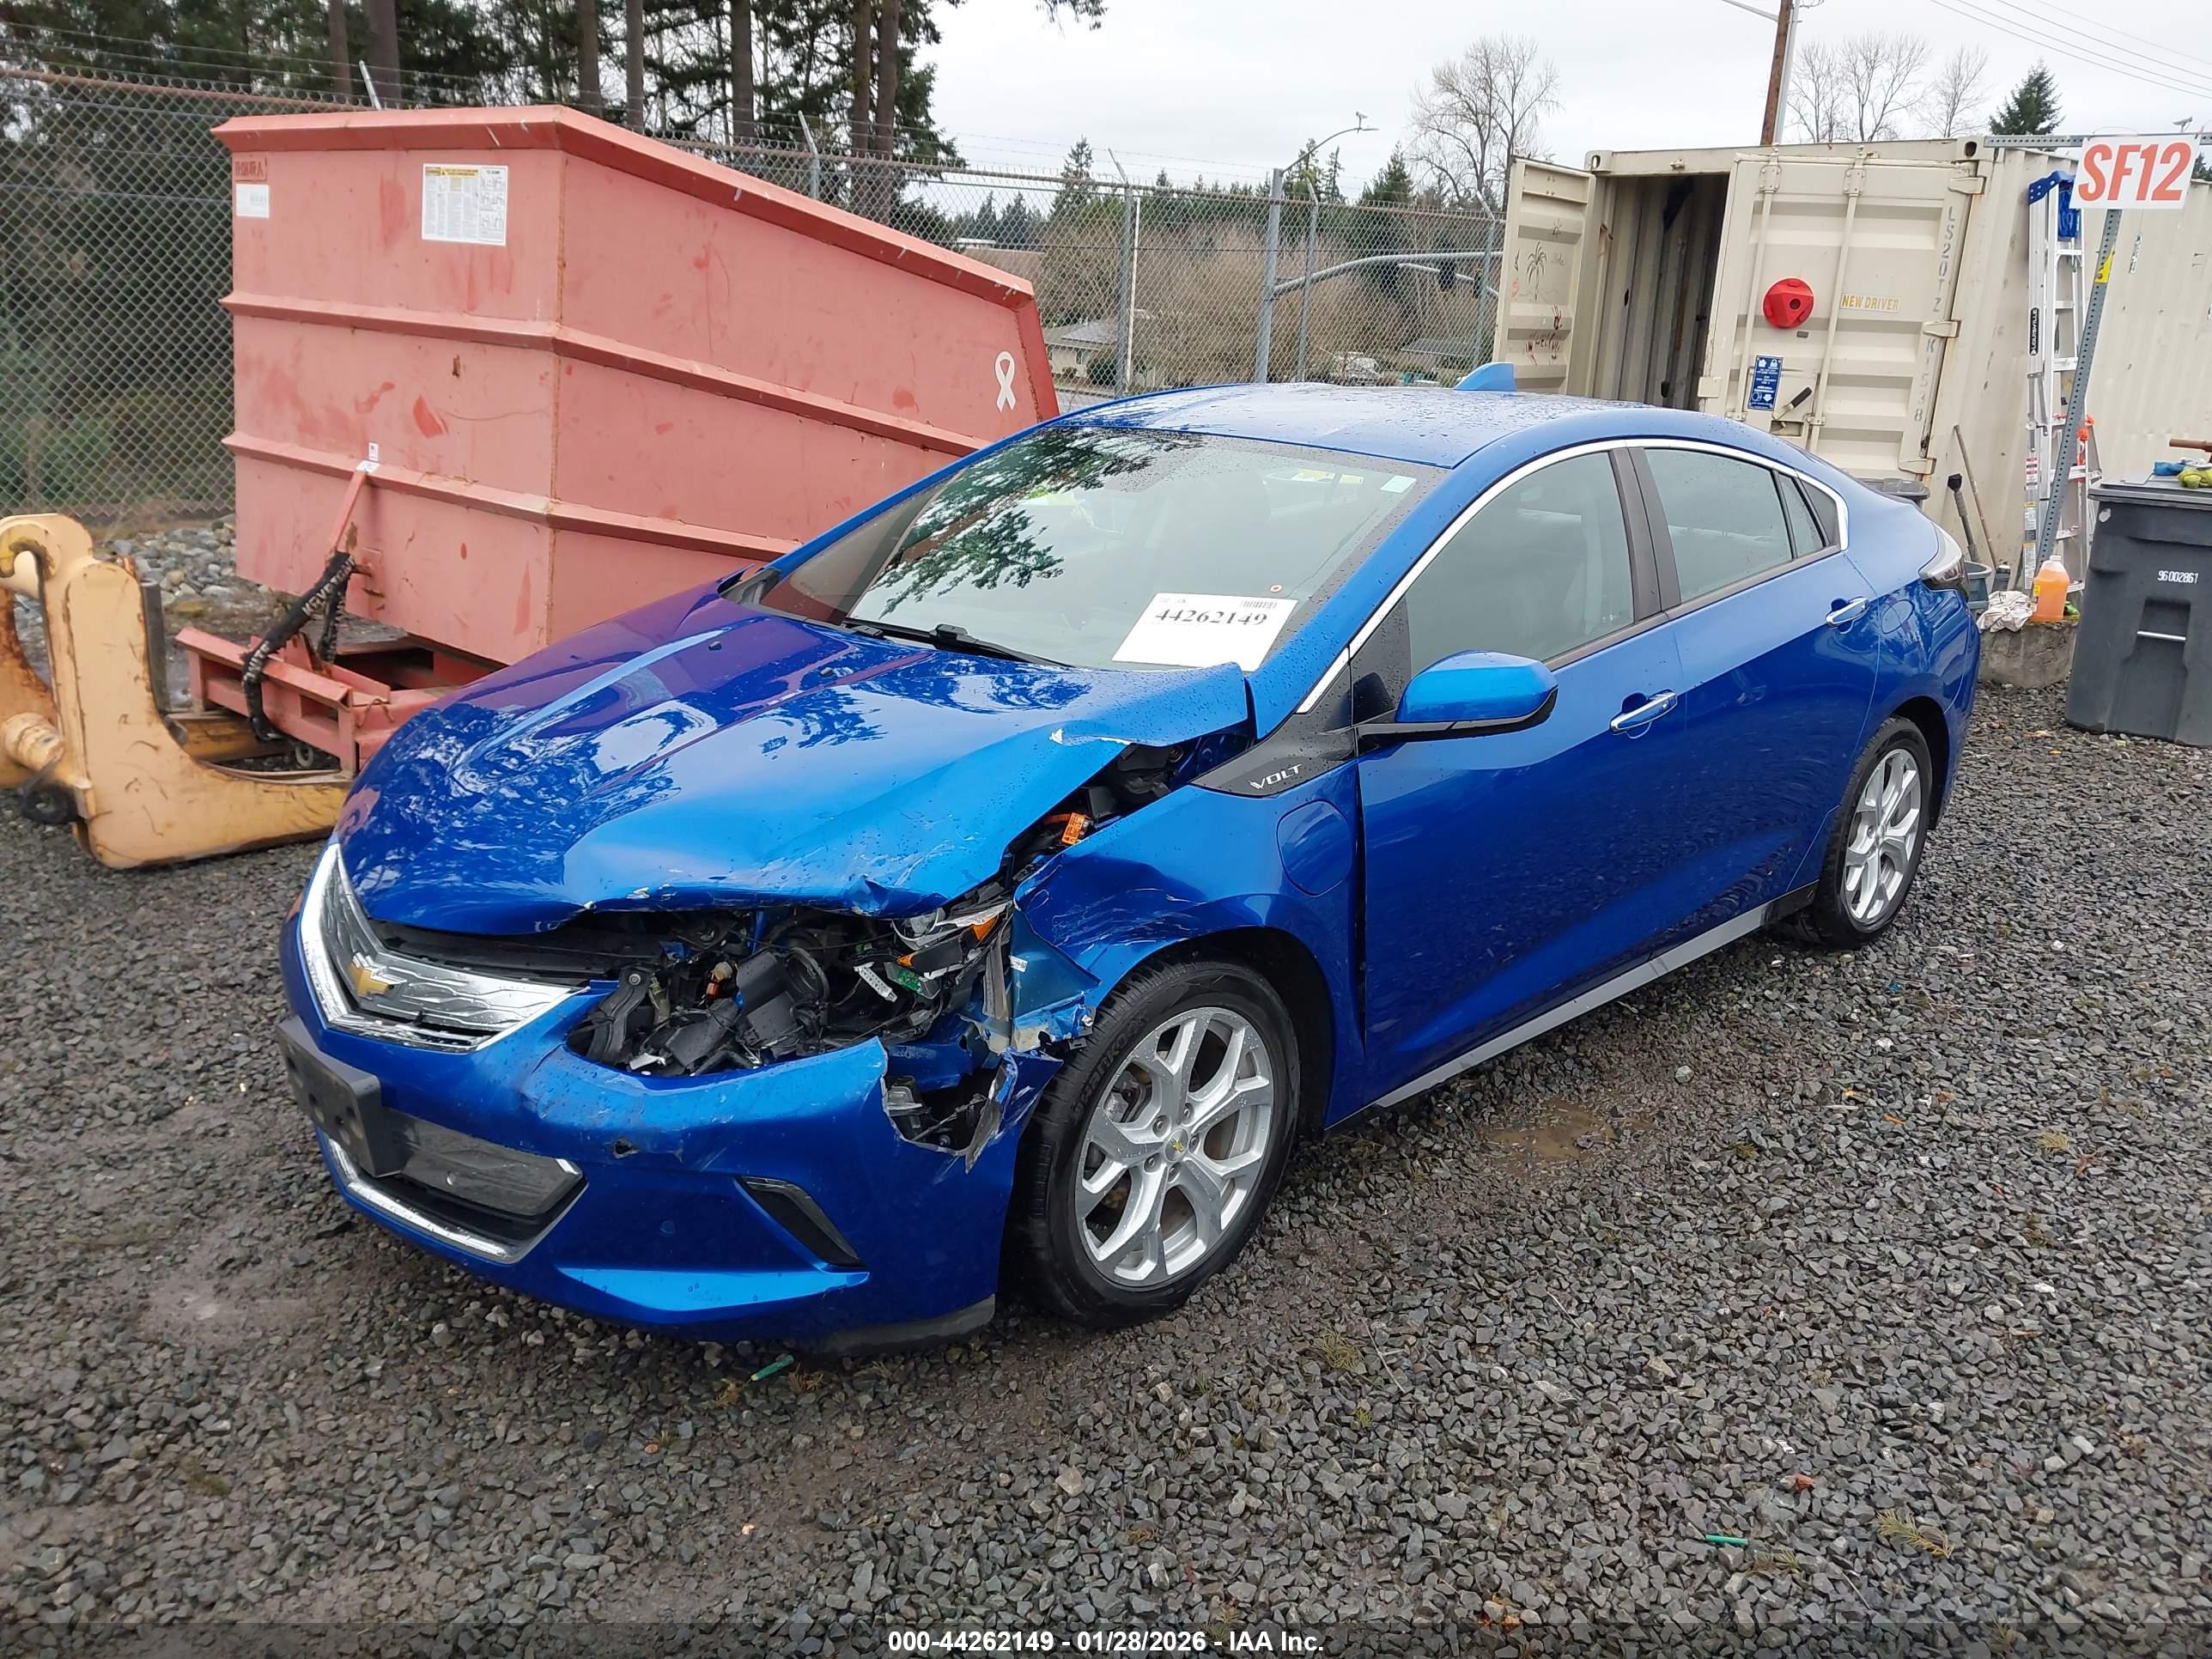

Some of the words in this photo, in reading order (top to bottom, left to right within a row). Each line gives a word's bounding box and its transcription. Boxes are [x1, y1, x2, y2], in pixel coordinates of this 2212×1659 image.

[2078, 142, 2192, 202] SF12
[1842, 295, 1863, 307] NEW
[1865, 296, 1899, 310] DRIVER
[2029, 308, 2038, 349] LOUISVILLE
[2157, 570, 2199, 584] 96002861
[1155, 608, 1268, 626] 44262149
[1247, 763, 1303, 790] VOLT
